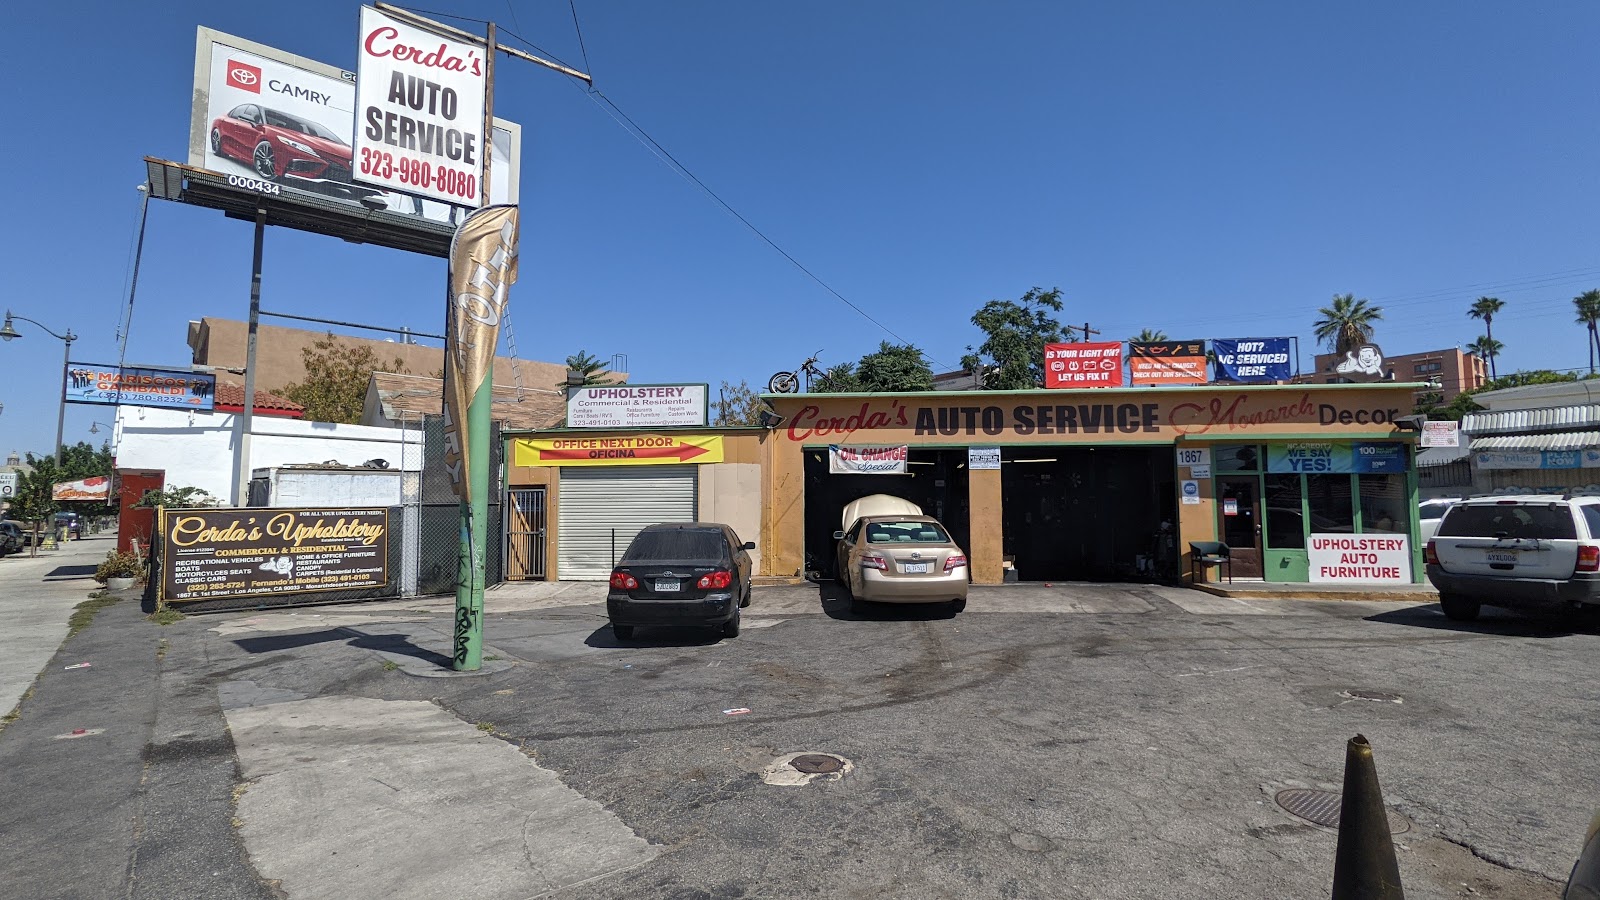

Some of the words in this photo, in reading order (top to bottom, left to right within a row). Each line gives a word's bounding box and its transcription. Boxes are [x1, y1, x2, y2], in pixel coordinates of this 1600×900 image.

[364, 26, 482, 77] Cerda's
[268, 79, 331, 106] CAMRY
[387, 69, 458, 121] AUTO
[366, 105, 476, 166] SERVICE
[360, 146, 476, 200] 323-980-8080
[228, 175, 280, 195] 000434
[1046, 350, 1054, 358] IS
[1056, 350, 1078, 358] YOUR
[1079, 349, 1103, 358] LIGHT
[1103, 348, 1120, 357] ON?
[1236, 342, 1264, 352] HOT?
[1236, 354, 1288, 364] SERVICED
[1086, 372, 1100, 380] FIX
[1237, 366, 1267, 376] HERE
[97, 372, 187, 387] MARISCOS
[96, 381, 186, 396] GARIBALDI
[588, 387, 686, 399] UPHOLSTERY
[131, 394, 183, 404] 780-8232
[914, 406, 1004, 436] AUTO
[1013, 403, 1160, 435] SERVICE
[1168, 393, 1316, 435] Monarch
[1319, 404, 1399, 426] Decor
[787, 399, 909, 442] Cerda's
[553, 440, 596, 449] OFFICE
[600, 438, 634, 448] NEXT
[636, 437, 674, 448] DOOR
[588, 450, 636, 459] OFICINA
[840, 448, 858, 461] OIL
[862, 446, 906, 461] CHANGE
[1180, 450, 1202, 462] 1867
[1288, 450, 1308, 458] WE
[1310, 449, 1332, 458] SAY
[1359, 446, 1376, 454] 100
[858, 461, 901, 472] Special
[1288, 458, 1332, 472] YES!
[172, 516, 262, 546] Cerda's
[266, 513, 385, 546] Upholstery
[1312, 538, 1404, 551] UPHOLSTERY
[215, 548, 280, 556] COMMERCIAL
[290, 546, 348, 554] RESIDENTIAL
[176, 558, 228, 566] RECREATIONAL
[1340, 553, 1378, 564] AUTO
[1320, 566, 1400, 578] FURNITURE
[187, 584, 208, 592] (323)
[210, 582, 246, 590] 263-5724
[251, 579, 294, 587] Fernando's
